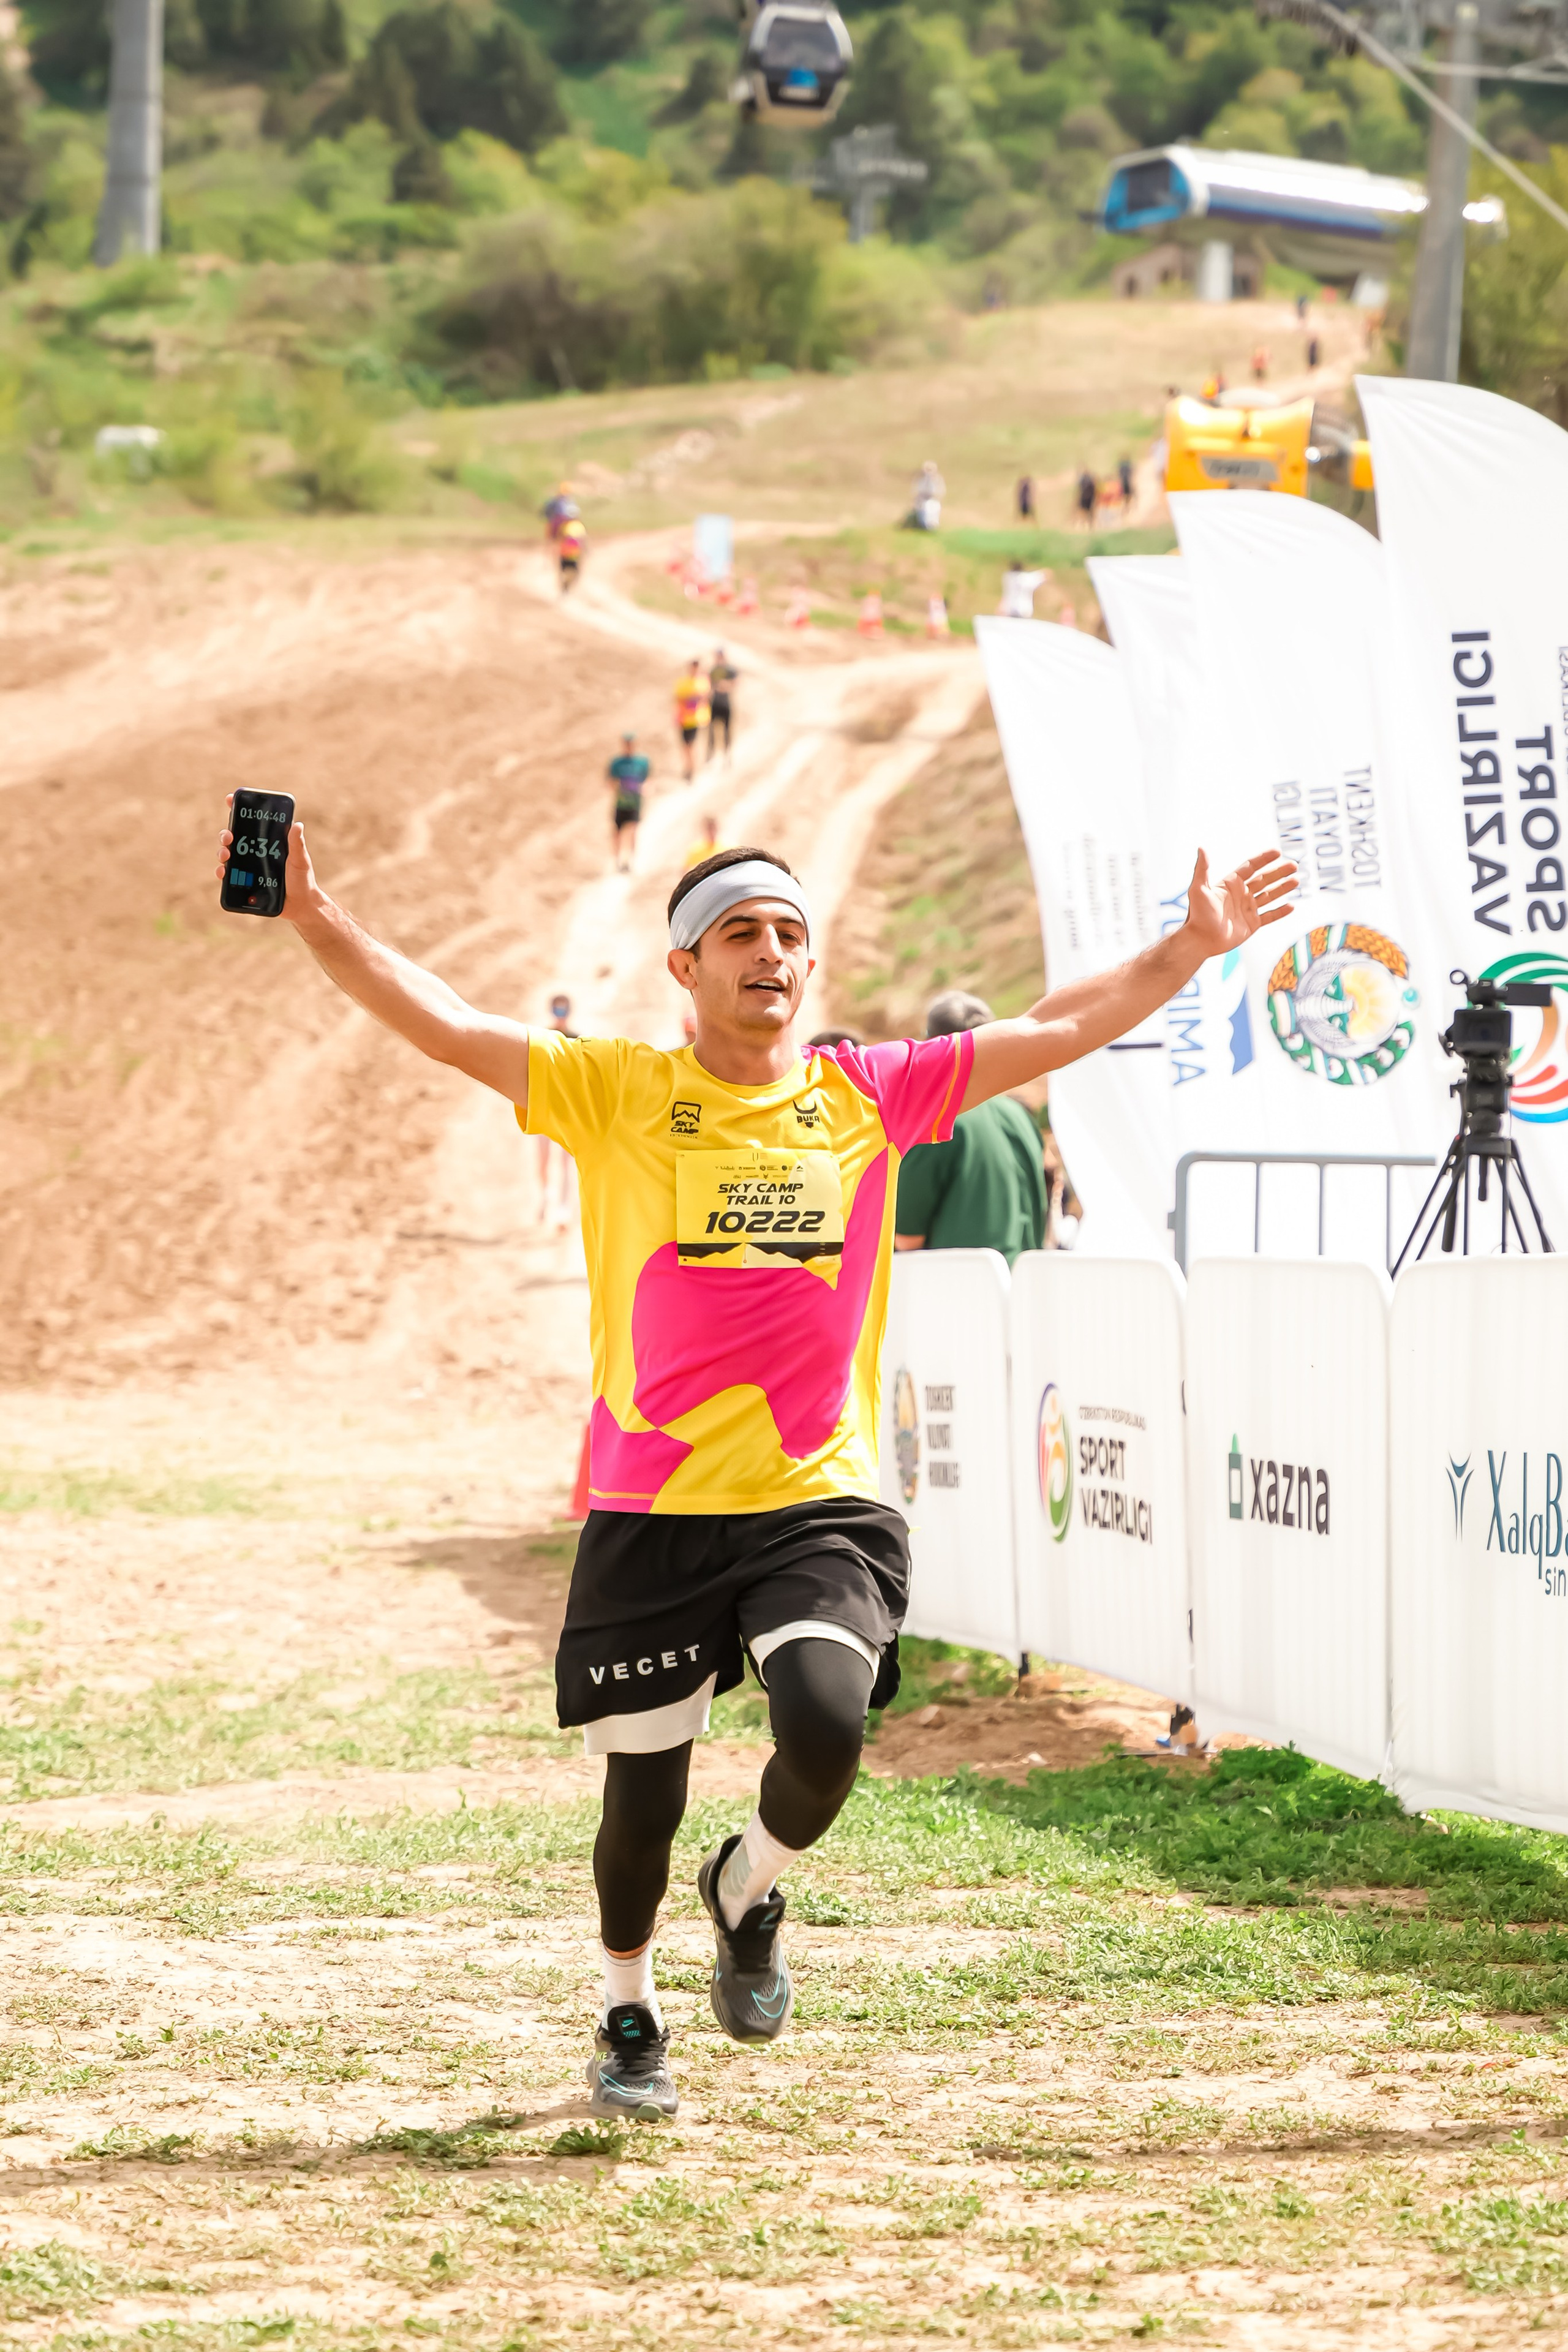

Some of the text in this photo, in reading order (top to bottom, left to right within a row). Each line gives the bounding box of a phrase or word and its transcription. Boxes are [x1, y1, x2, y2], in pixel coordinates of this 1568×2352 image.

[240, 807, 286, 823] 01:04:48
[236, 835, 281, 859] 6:34
[258, 876, 278, 888] 9,86
[797, 1115, 820, 1124] BUKA
[717, 1183, 804, 1193] SKY CAMP
[726, 1195, 796, 1205] TRAIL 10
[705, 1210, 826, 1234] 10222
[1080, 1437, 1126, 1481] SPORT
[1250, 1458, 1330, 1535] xazna
[1080, 1488, 1153, 1545] VAZIRLIGI
[589, 1644, 700, 1684] VECET
